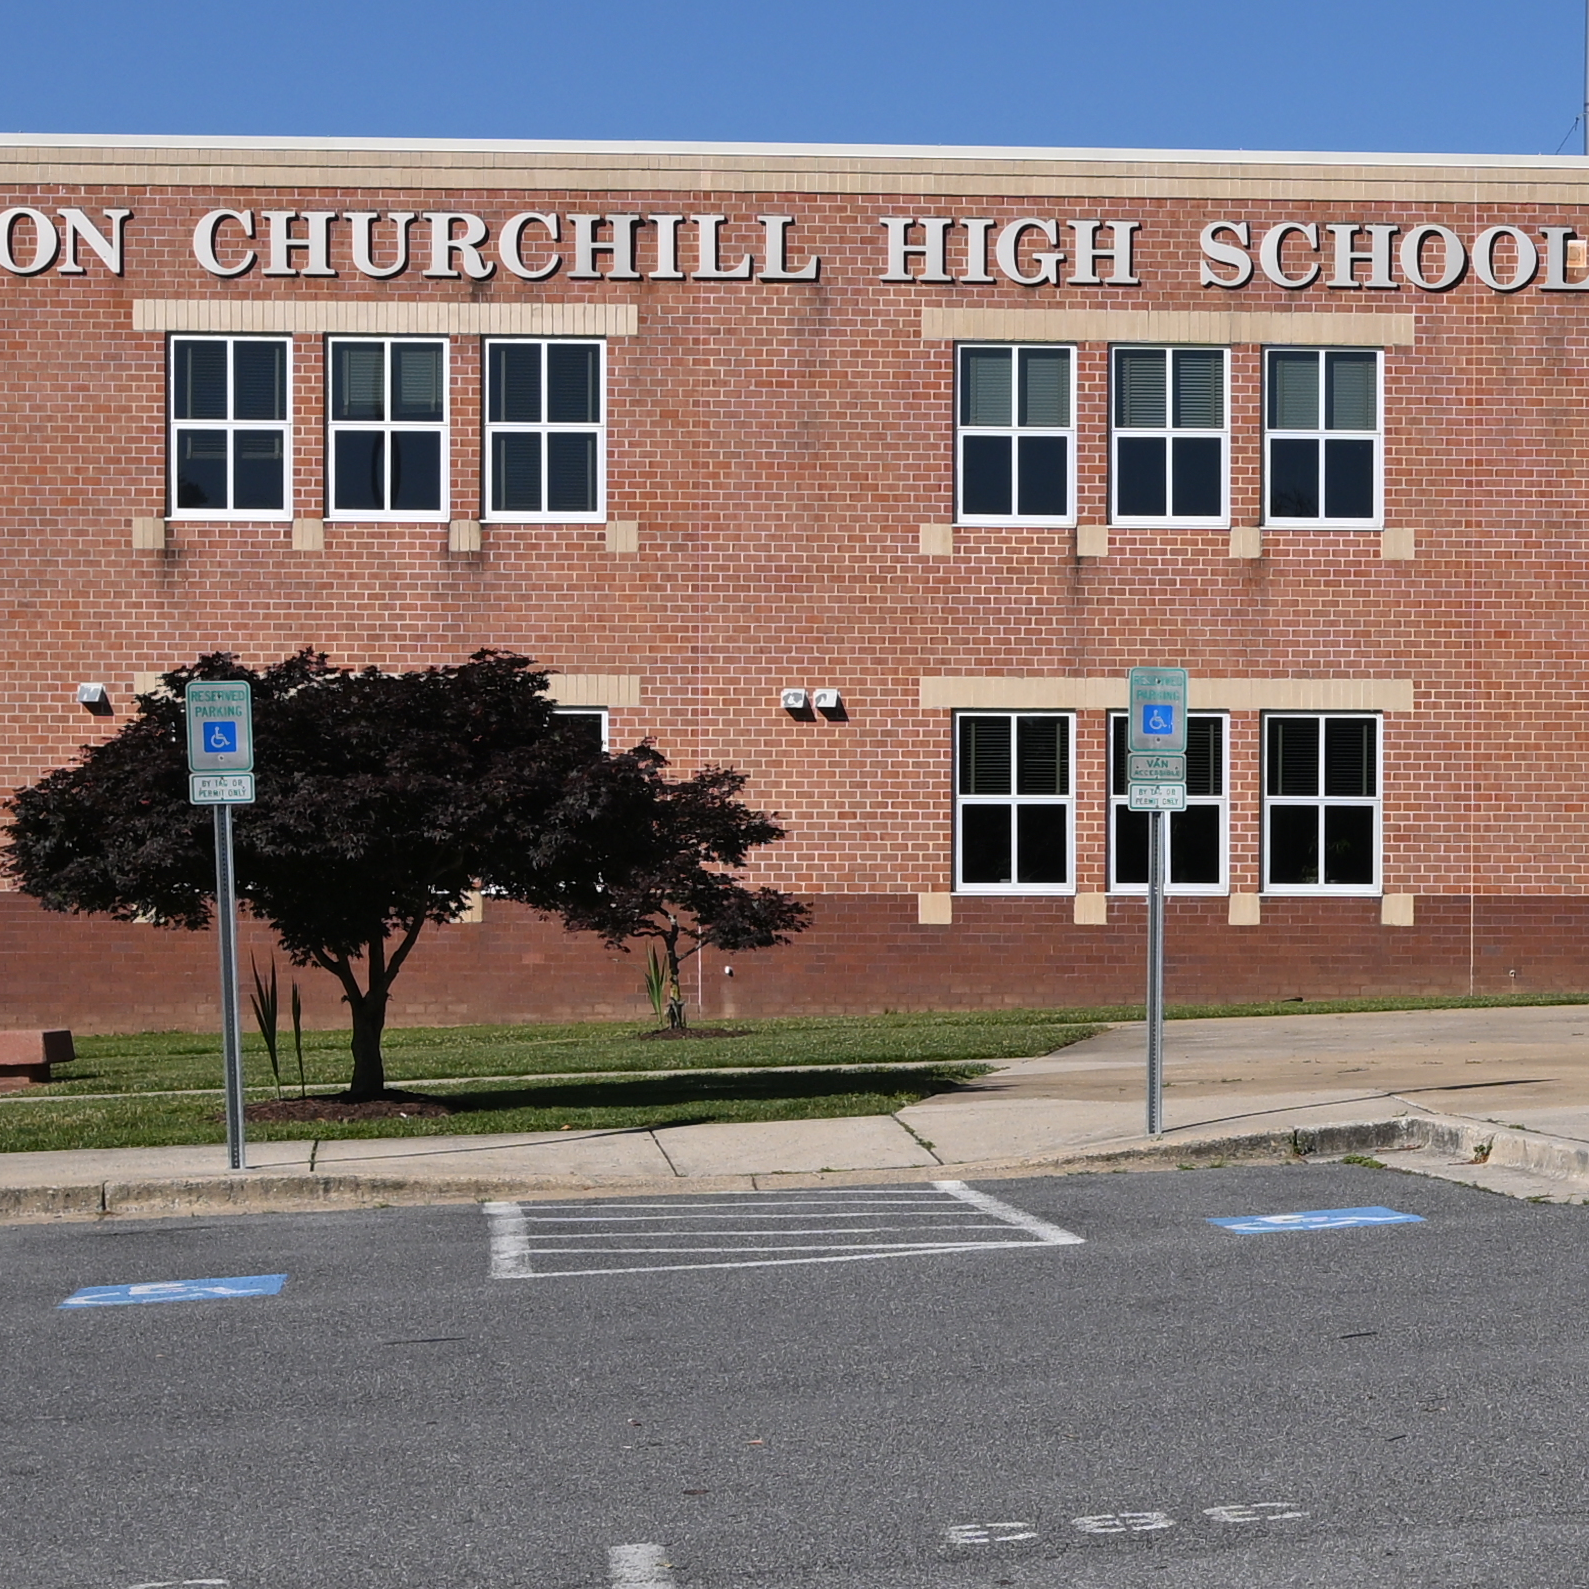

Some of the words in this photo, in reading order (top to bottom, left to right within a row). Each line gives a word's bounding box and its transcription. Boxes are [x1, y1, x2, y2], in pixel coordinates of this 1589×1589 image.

[192, 208, 819, 284] CHURCHILL
[878, 215, 1142, 288] HIGH
[191, 690, 245, 702] RESERVED
[1136, 690, 1180, 701] PARKING
[195, 705, 242, 717] PARKING
[1146, 759, 1169, 769] VAN
[1134, 769, 1180, 777] ACCESSIBLE
[201, 779, 211, 788] BY
[198, 789, 224, 798] PERMIT
[227, 788, 247, 798] ONLY
[1138, 787, 1147, 796] BY
[941, 1501, 1311, 1544] 383
